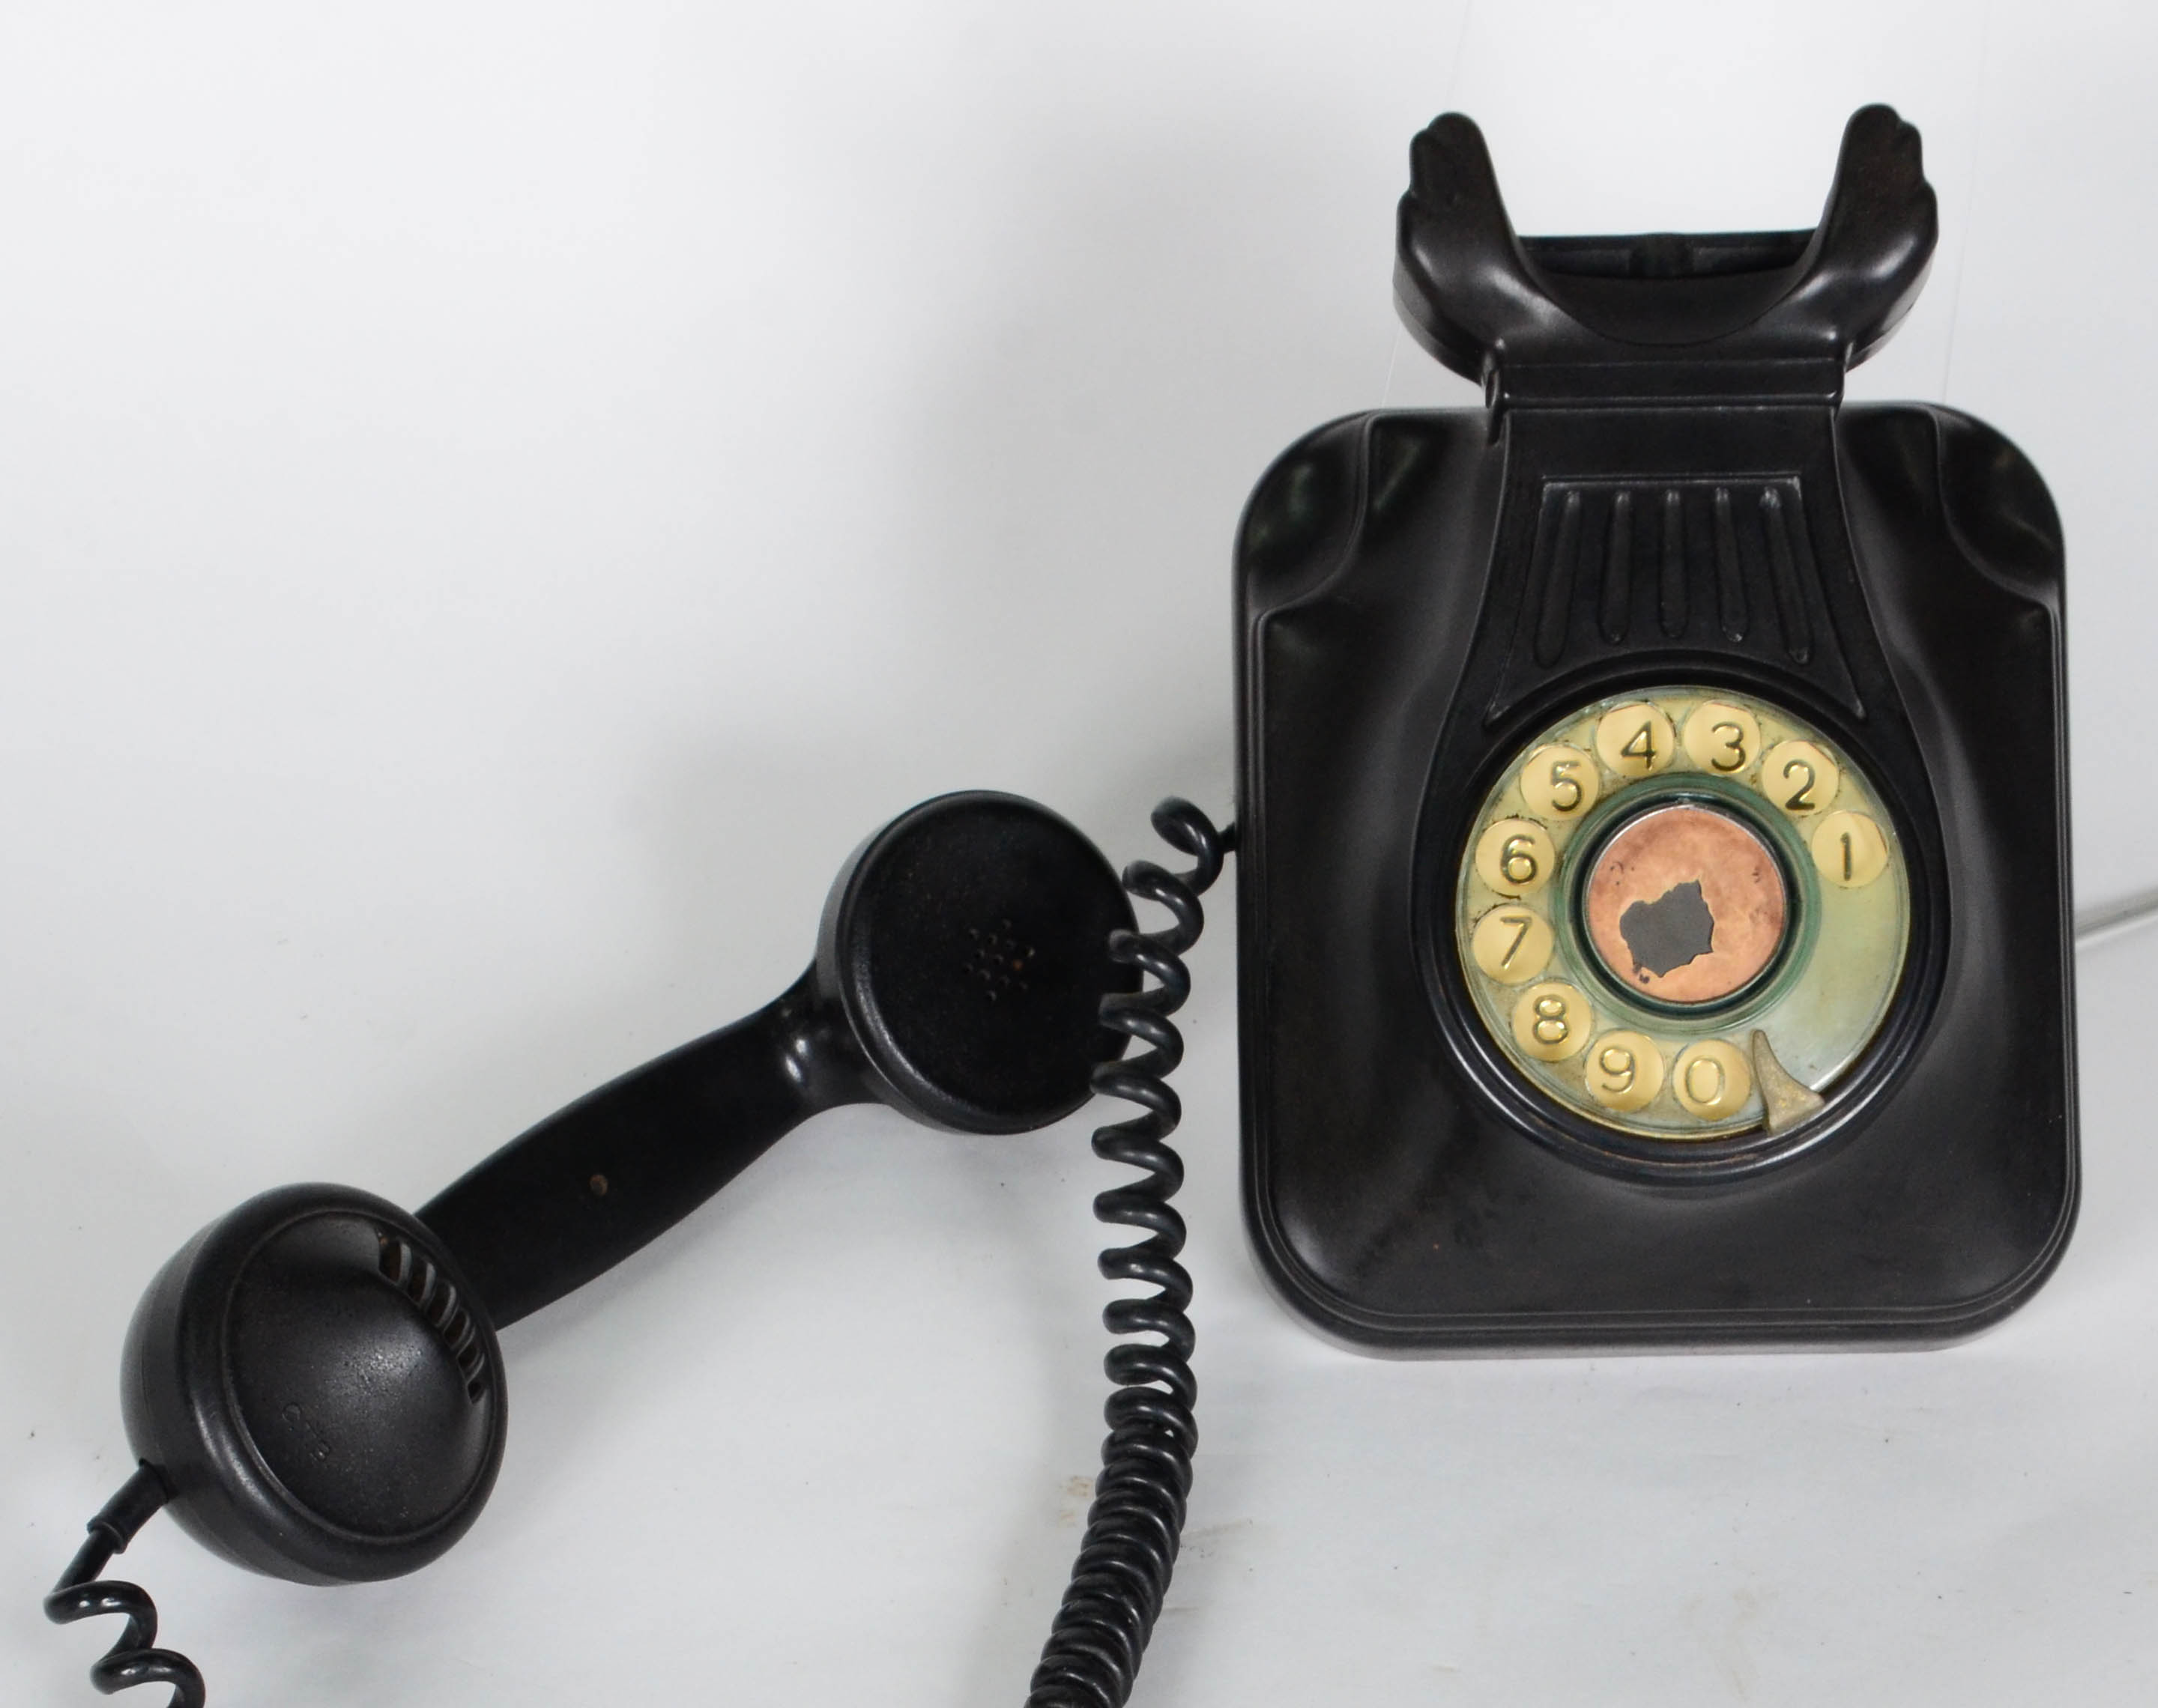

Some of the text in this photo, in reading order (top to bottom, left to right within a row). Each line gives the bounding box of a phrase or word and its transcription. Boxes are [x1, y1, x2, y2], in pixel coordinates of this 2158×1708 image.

[1622, 721, 1656, 770] 4
[1711, 722, 1747, 772] 3
[1550, 760, 1582, 811] 5
[1783, 760, 1814, 811] 2
[1501, 834, 1537, 884] 6
[1838, 832, 1851, 880] 1
[1501, 915, 1532, 969] 7
[1532, 994, 1569, 1044] 8
[1598, 1048, 1635, 1093] 9
[1685, 1057, 1723, 1104] 0
